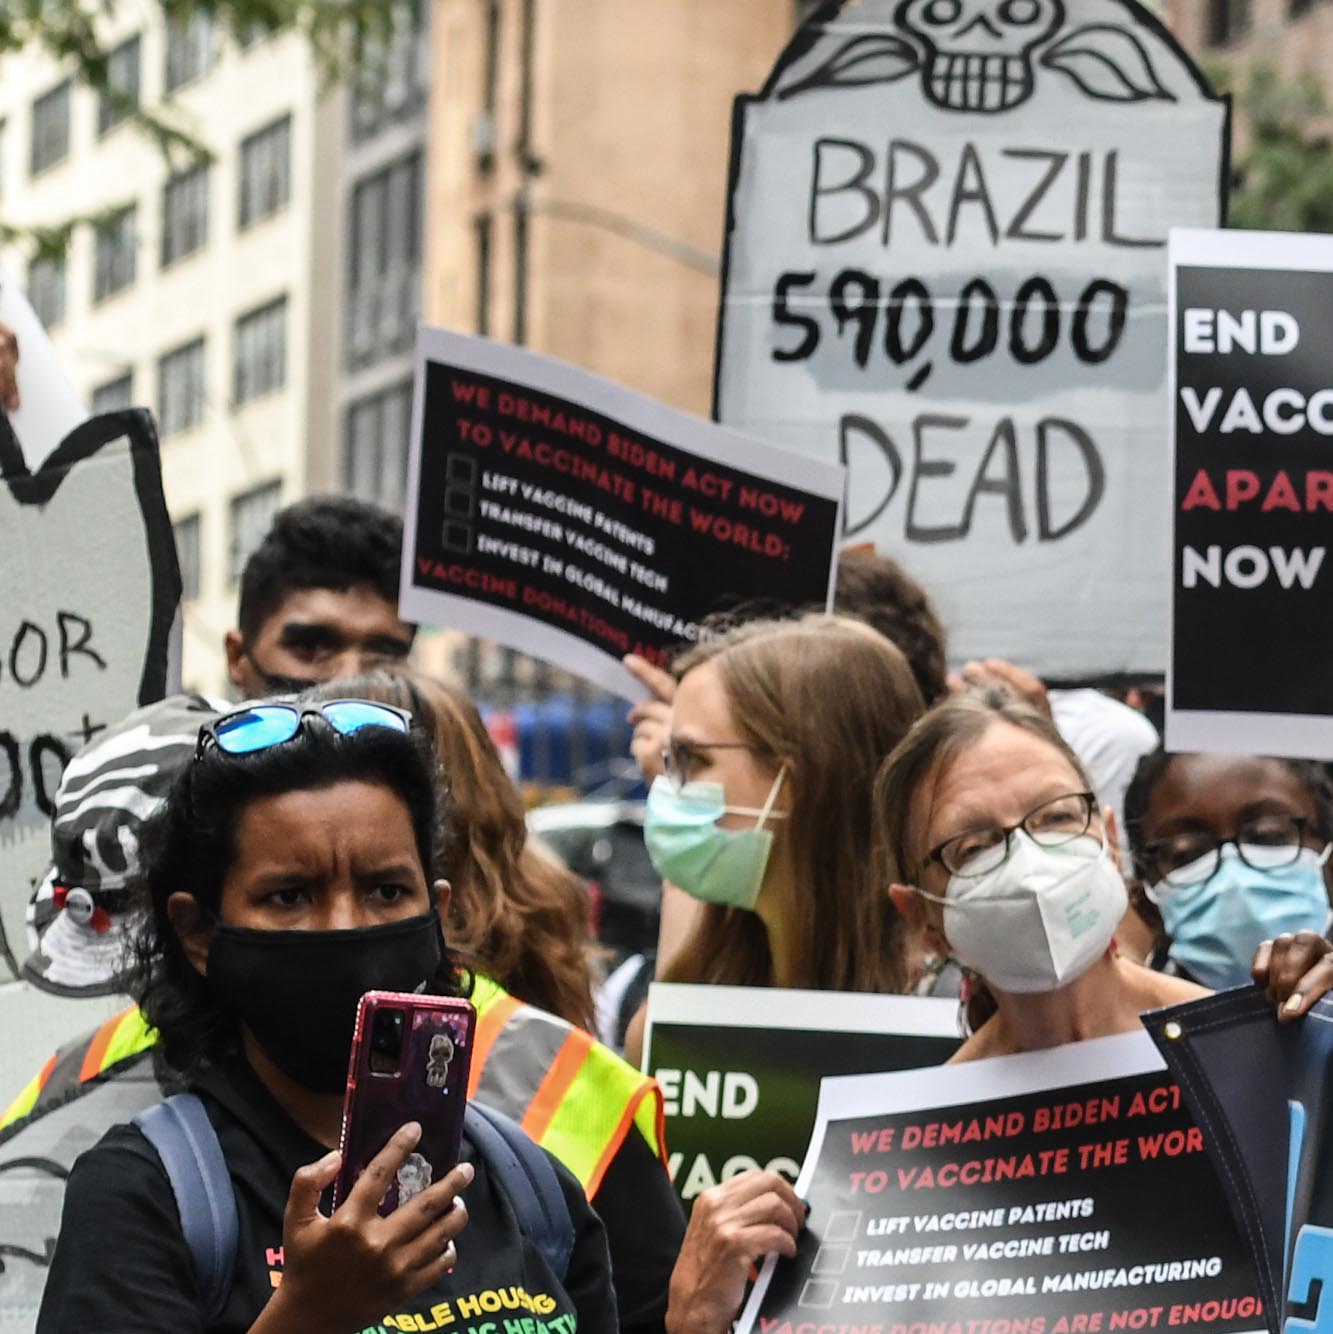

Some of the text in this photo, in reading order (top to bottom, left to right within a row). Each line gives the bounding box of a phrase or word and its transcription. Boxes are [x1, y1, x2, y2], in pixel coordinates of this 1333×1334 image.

[810, 137, 1168, 250] BRAZIL
[771, 268, 1129, 391] 590,000
[1184, 309, 1299, 354] END
[450, 380, 805, 523] WE DEMAND BIDEN ACT NOW
[841, 413, 1105, 545] DEAD
[457, 419, 790, 560] TO VACCINATE THE WORLD:
[483, 472, 656, 555] LIFT VACCINE PATENTS
[477, 536, 538, 568] INVEST
[543, 554, 563, 574] IN
[565, 561, 619, 602] GLOBAL
[480, 500, 668, 593] TRANSFER VACCINE TECH
[1181, 545, 1326, 590] NOW
[418, 557, 517, 601] VACCINE
[522, 585, 630, 653] DONATIONS
[0, 609, 107, 688] OR
[655, 1068, 760, 1119] END
[850, 1128, 892, 1155] WE
[901, 1111, 1024, 1150] DEMAND
[1033, 1096, 1120, 1133] BIDEN
[849, 1126, 1206, 1195] TO VACCINATE THE WOR
[856, 1230, 1111, 1268] TRANSFER VACCINE TECH
[866, 1197, 1094, 1236] LIFT VACCINE PATENTS
[842, 1256, 1222, 1304] INVEST IN GLOBAL MANUFACTURING
[1051, 1313, 1103, 1334] ARE
[1108, 1307, 1164, 1331] NOT
